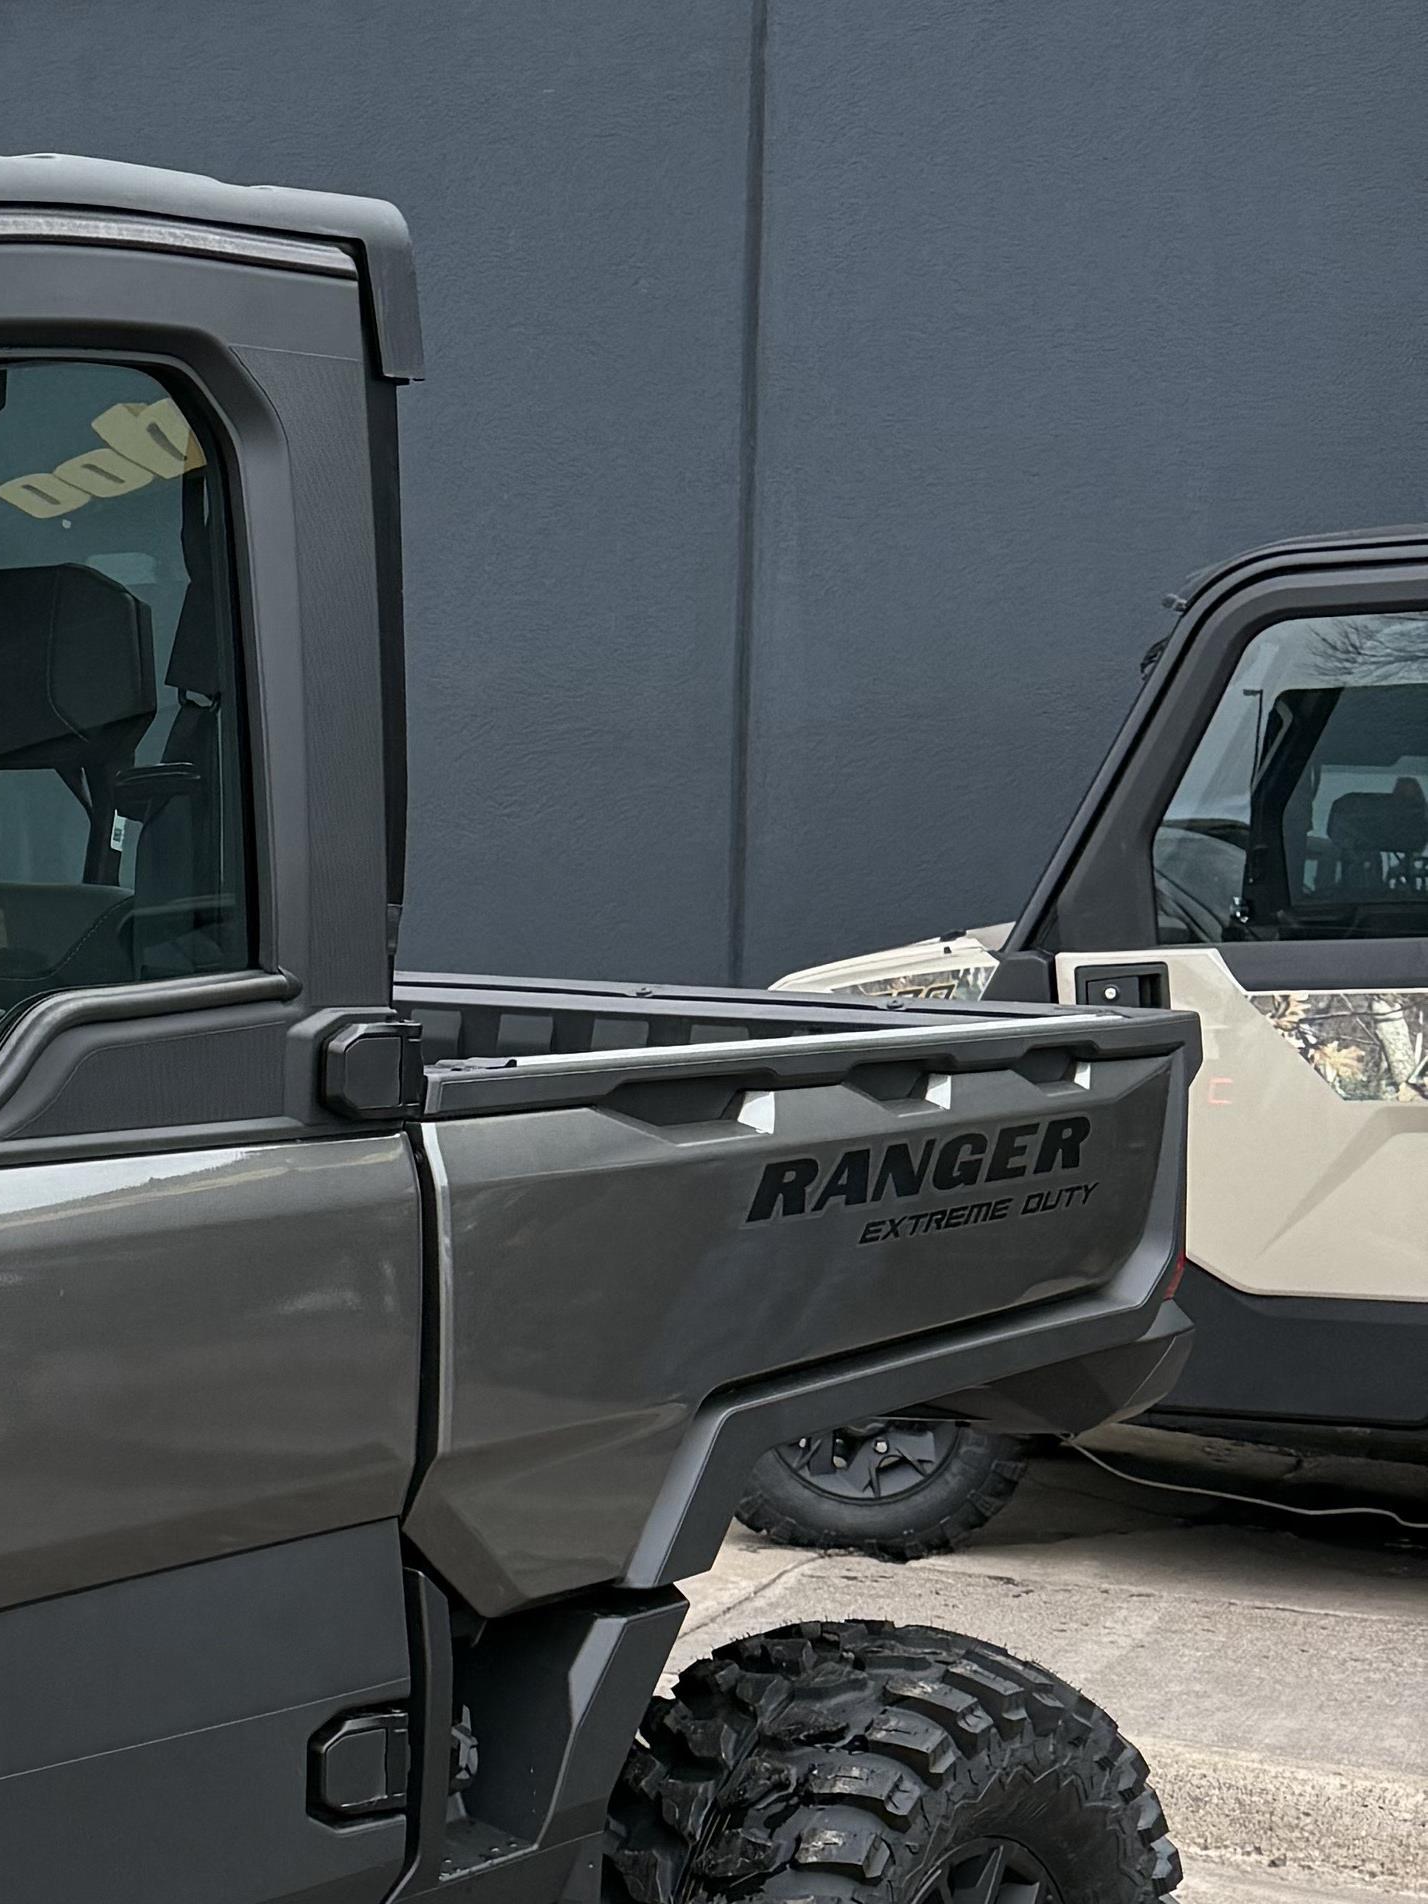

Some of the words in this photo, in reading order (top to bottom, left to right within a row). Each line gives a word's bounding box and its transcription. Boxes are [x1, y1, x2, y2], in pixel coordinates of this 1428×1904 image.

[744, 1115, 1092, 1224] RANGER
[857, 1197, 1015, 1245] EXTREME
[1020, 1182, 1100, 1216] DUTY
